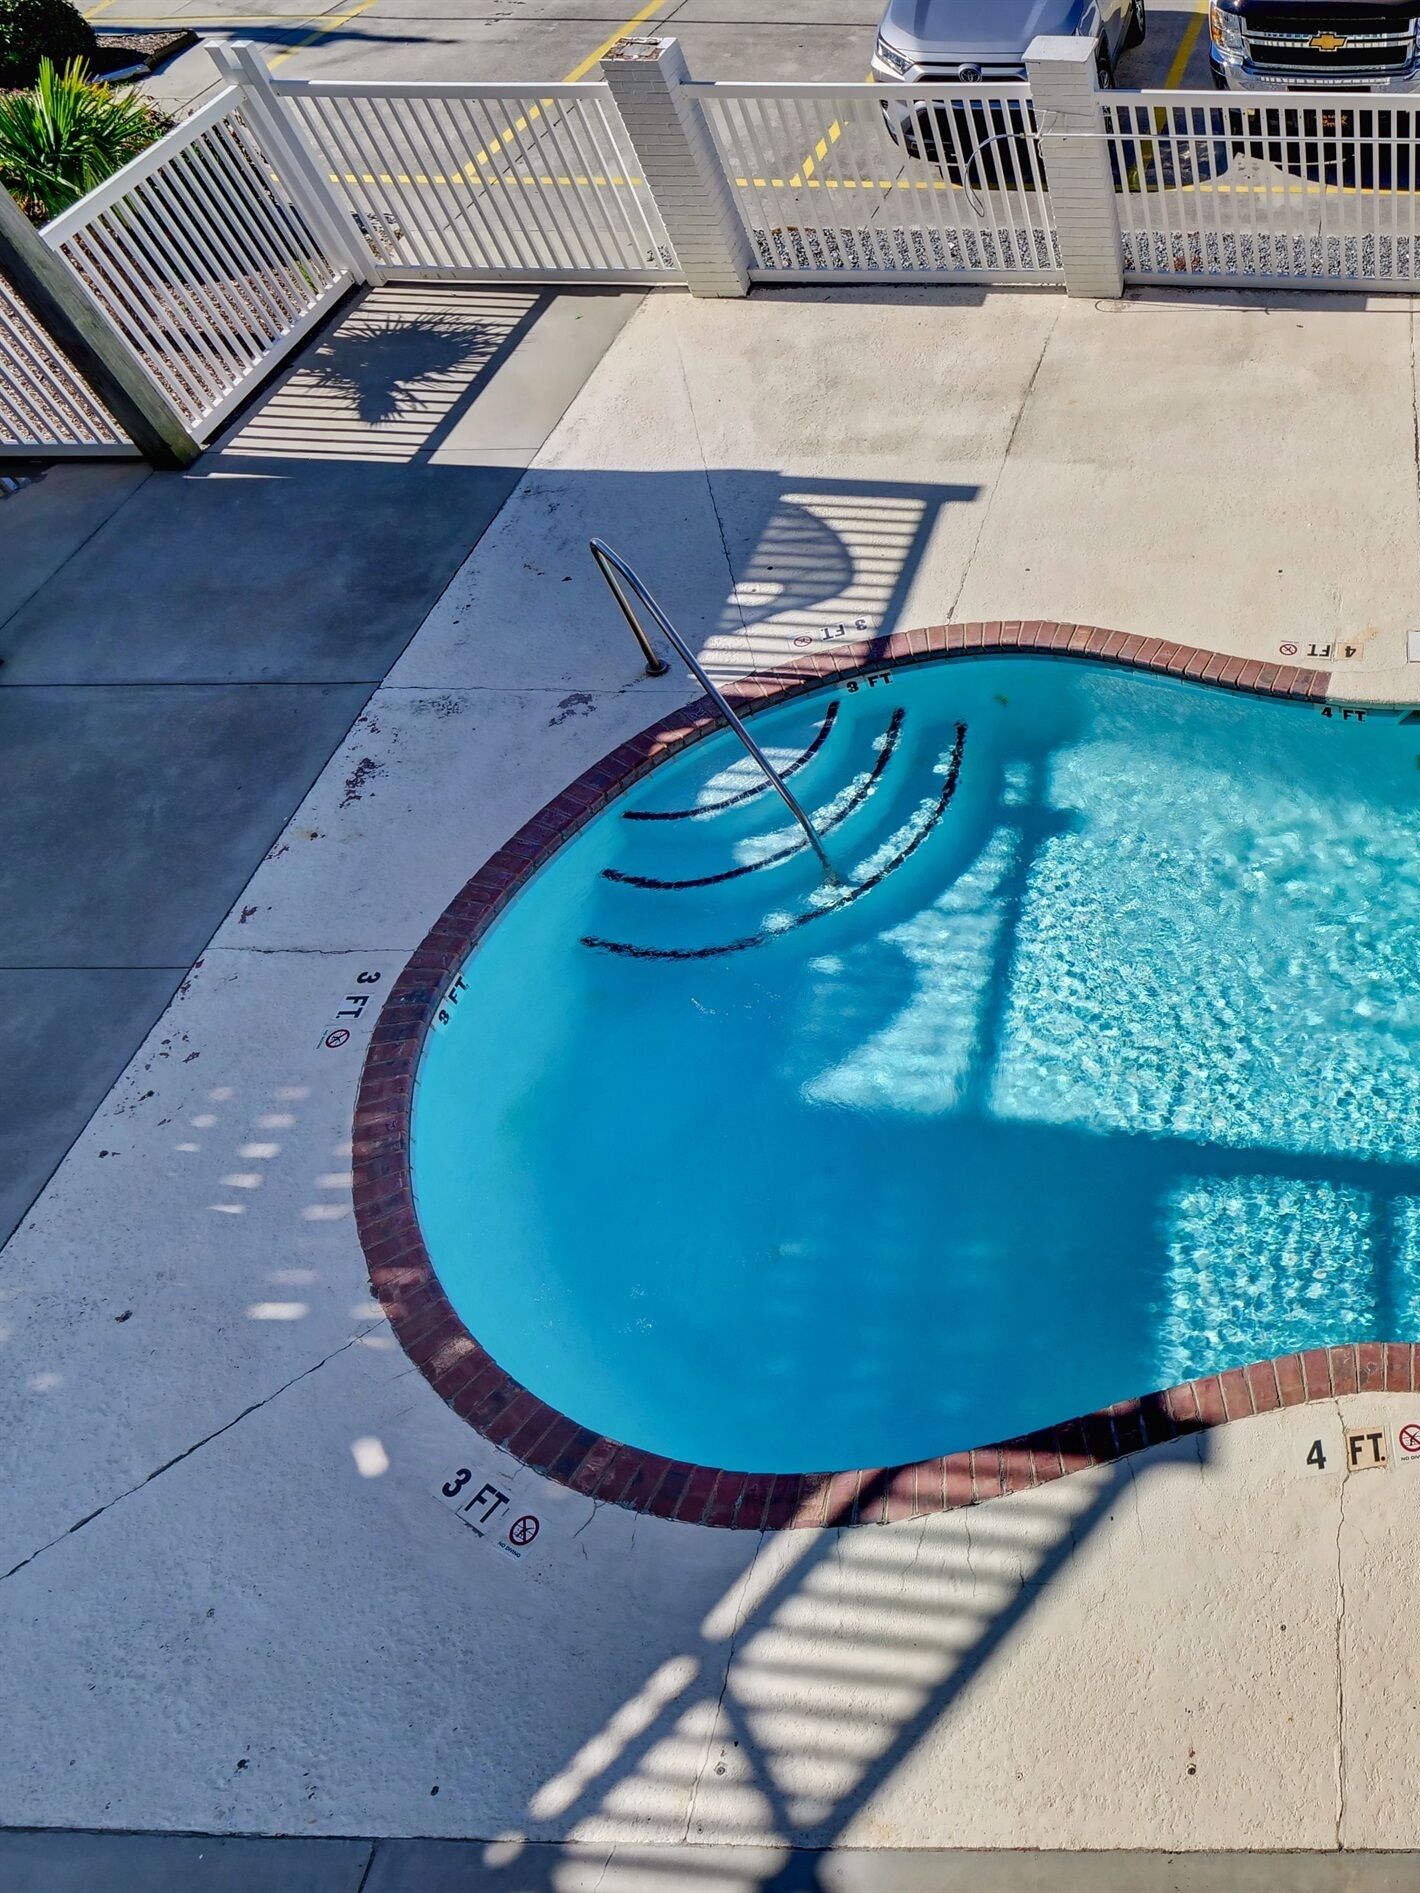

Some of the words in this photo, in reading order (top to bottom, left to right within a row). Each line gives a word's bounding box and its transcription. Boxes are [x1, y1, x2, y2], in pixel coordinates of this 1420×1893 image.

[855, 619, 867, 631] 3
[1345, 646, 1356, 658] 4
[846, 682, 858, 693] 3
[1321, 707, 1332, 718] 4
[357, 972, 381, 984] 3
[439, 1010, 449, 1025] 3
[1306, 1440, 1326, 1470] 4
[1350, 1432, 1386, 1465] FT.
[442, 1468, 472, 1497] 3
[464, 1483, 510, 1523] FT
[505, 1546, 521, 1558] DIVING
